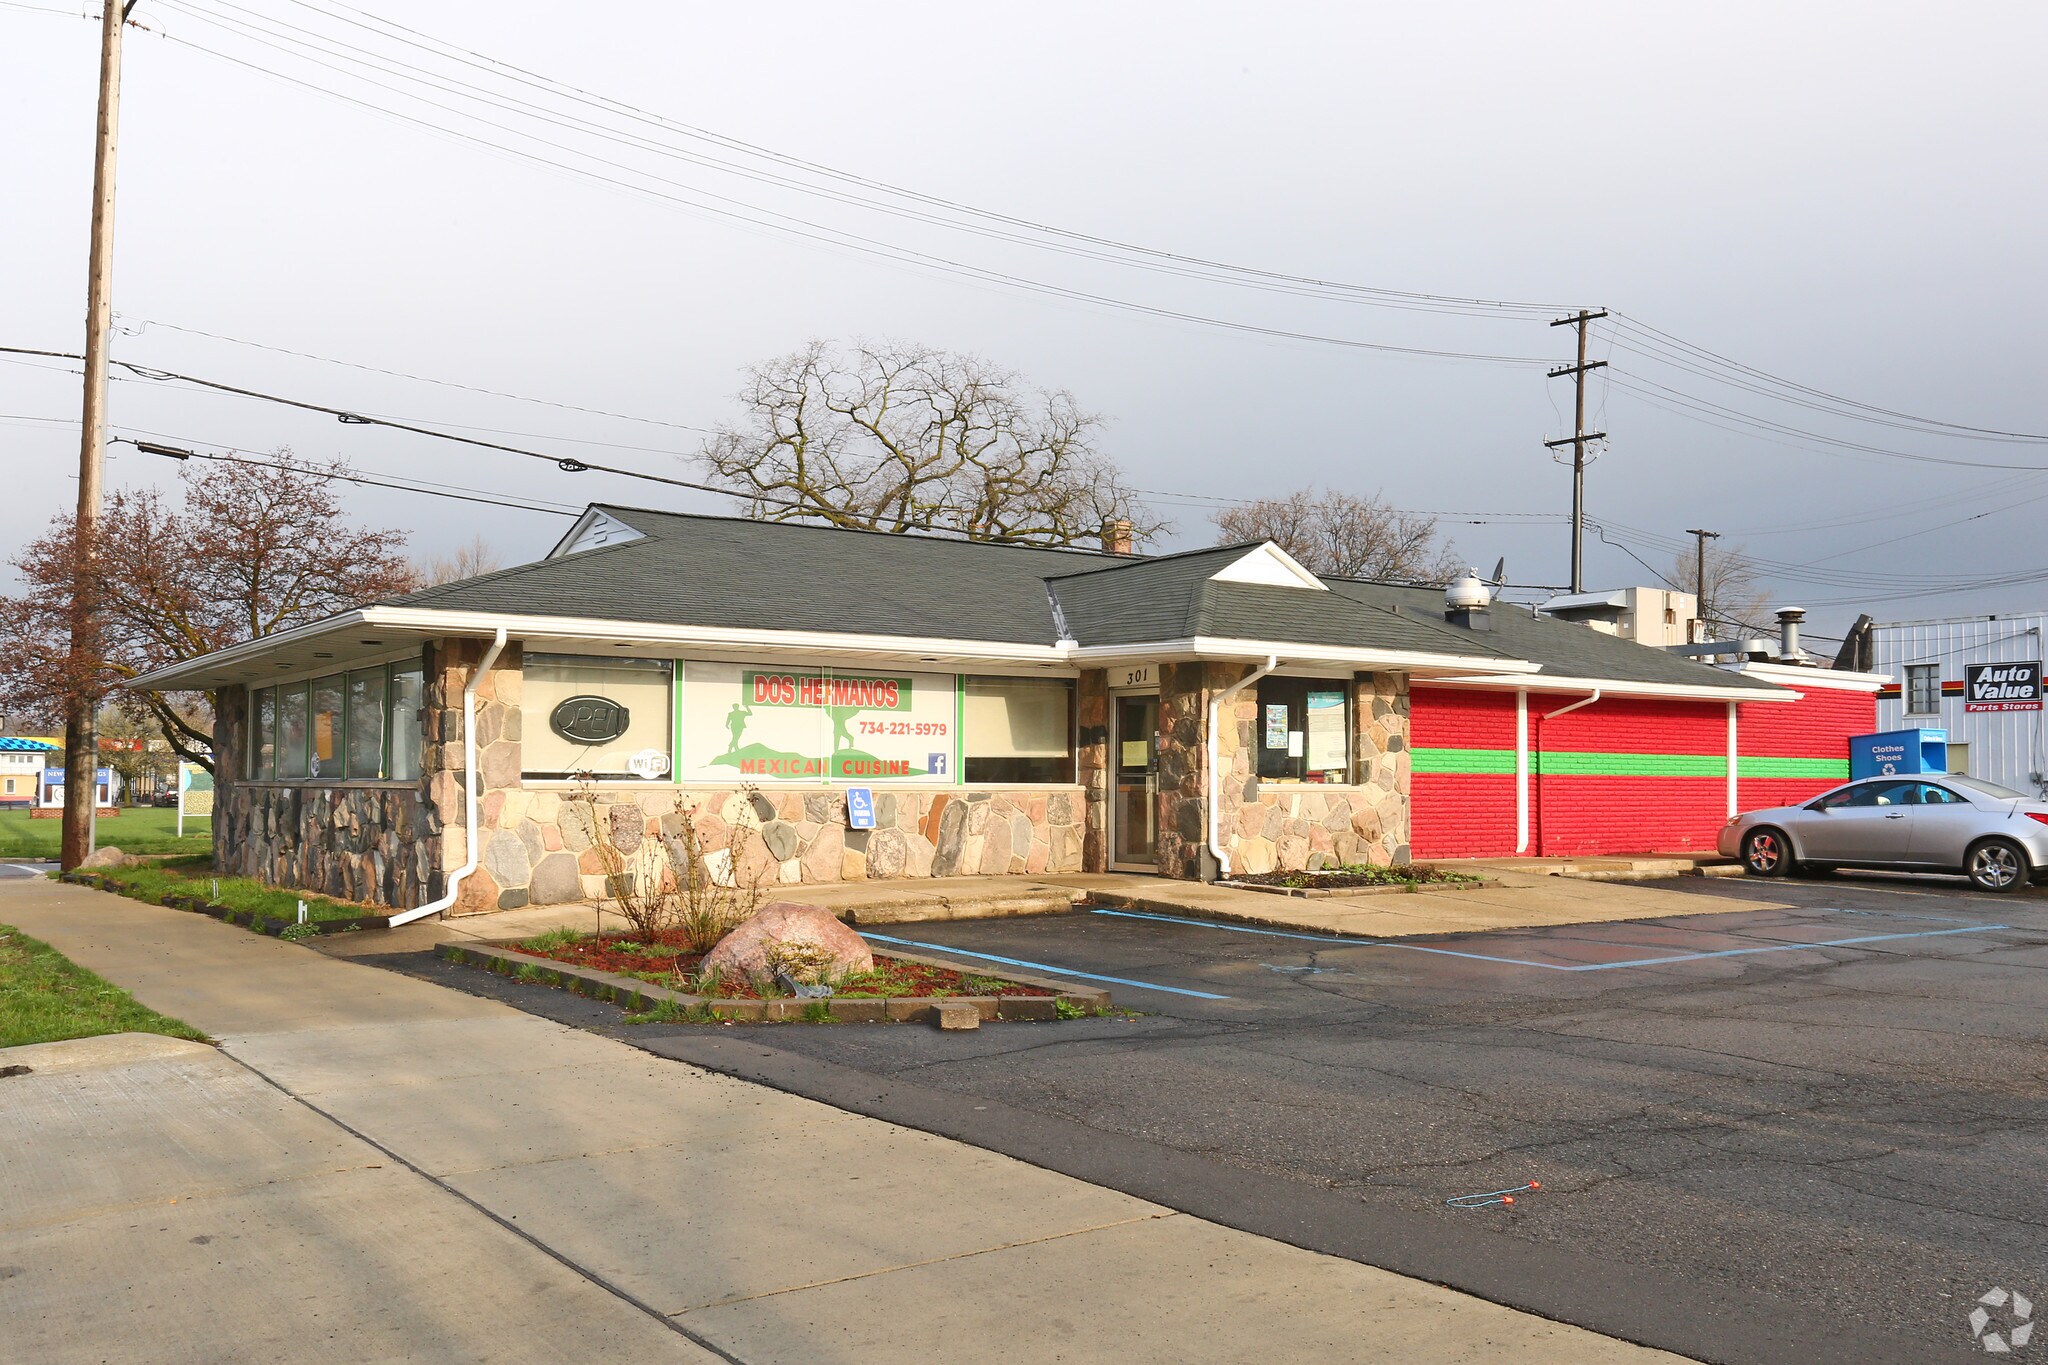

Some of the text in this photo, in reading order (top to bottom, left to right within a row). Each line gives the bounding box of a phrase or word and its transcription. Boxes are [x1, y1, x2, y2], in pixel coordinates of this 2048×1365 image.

[1127, 668, 1147, 684] 301
[1976, 666, 2031, 683] Auto
[754, 675, 899, 708] DOS HERMANOS
[1973, 683, 2034, 699] Value
[2001, 703, 2039, 711] Stores
[556, 704, 627, 732] OPEN
[859, 721, 947, 736] 734-221-5979
[1872, 745, 1905, 754] Clothes
[1875, 754, 1902, 762] Shoes
[740, 759, 910, 775] MEXICAN CUISINE
